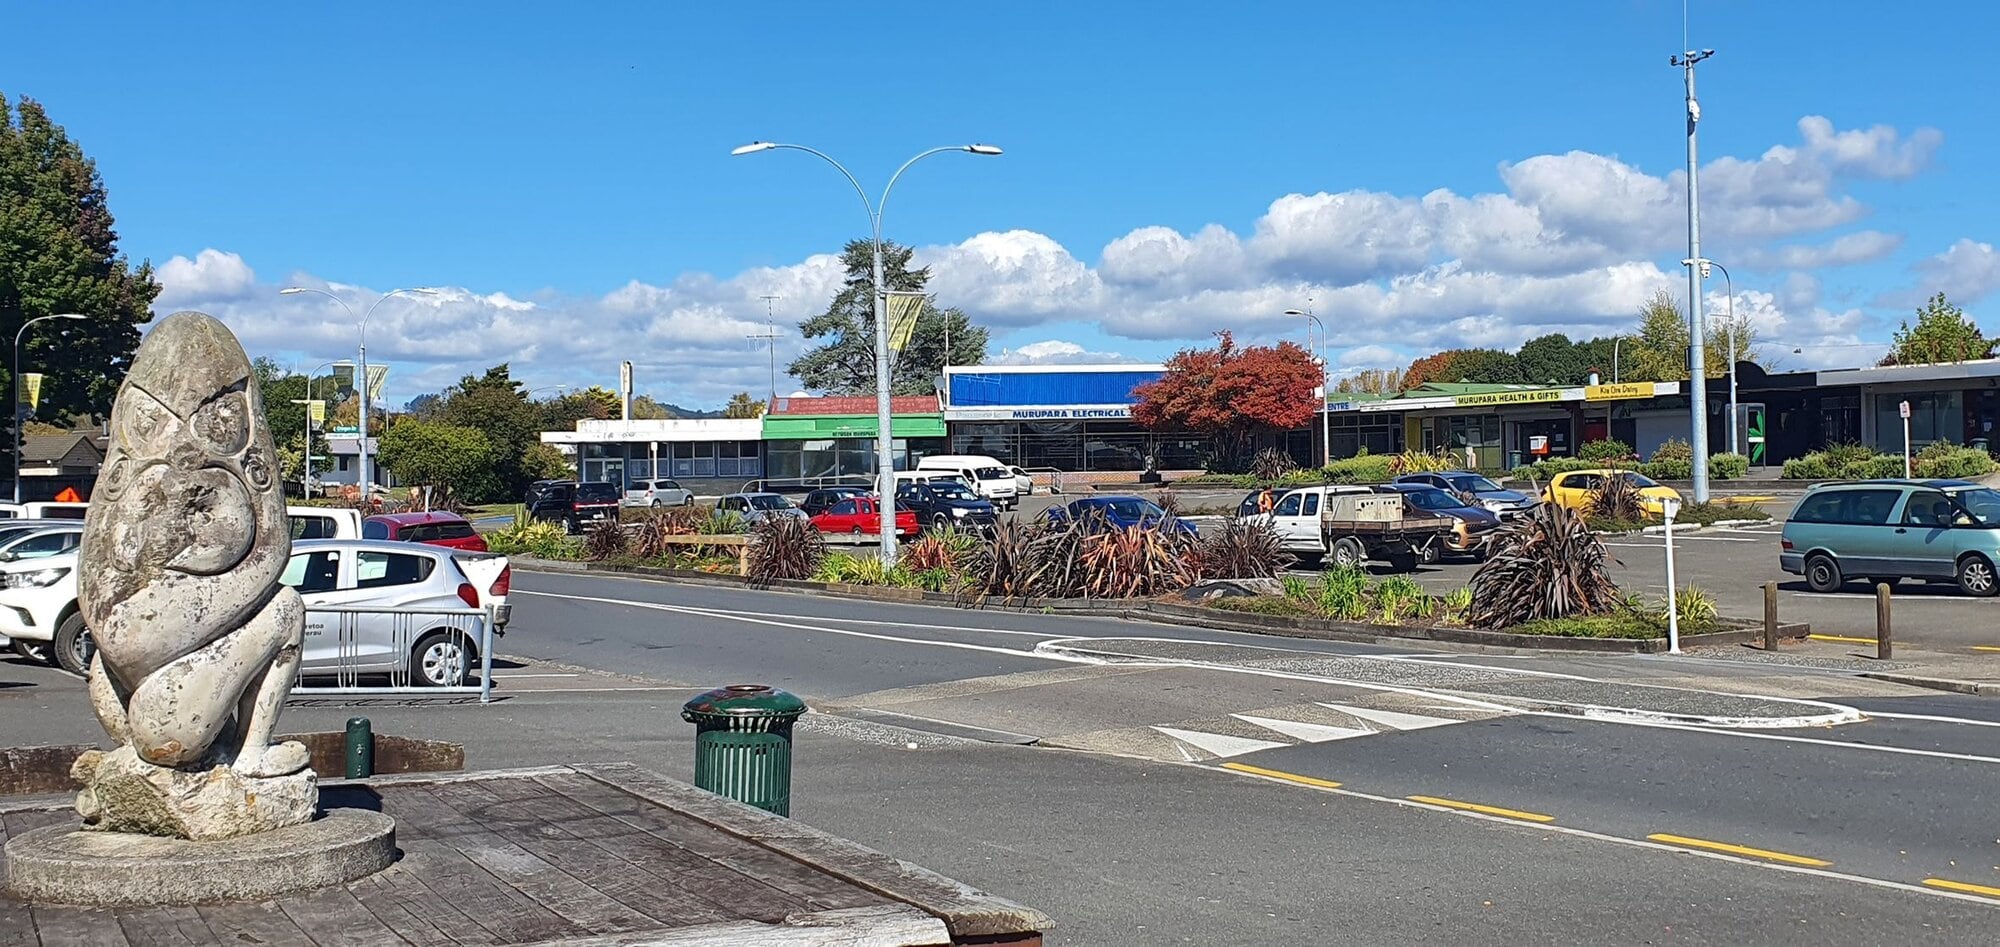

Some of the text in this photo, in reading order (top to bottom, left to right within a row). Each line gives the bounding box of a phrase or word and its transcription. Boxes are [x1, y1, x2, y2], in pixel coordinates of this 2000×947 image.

[1458, 395, 1497, 404] MURUPARA
[1500, 393, 1528, 402] HEALTH
[1538, 392, 1559, 400] GIFTS
[1327, 402, 1349, 410] ENTRE
[1012, 409, 1126, 418] MURUPARA ELECTRICAL
